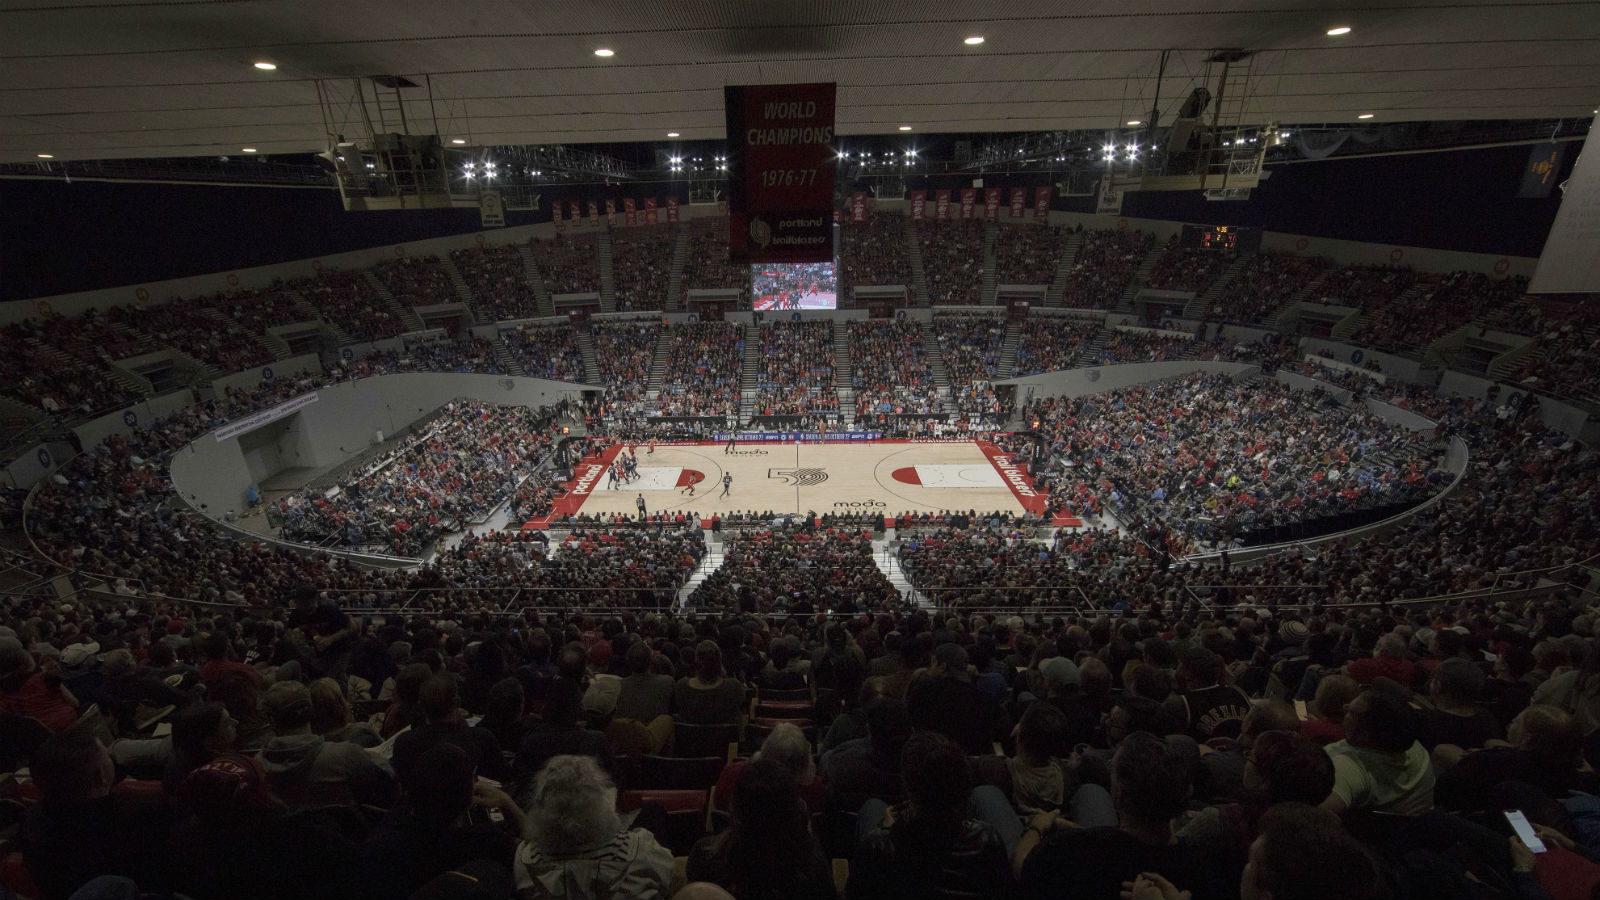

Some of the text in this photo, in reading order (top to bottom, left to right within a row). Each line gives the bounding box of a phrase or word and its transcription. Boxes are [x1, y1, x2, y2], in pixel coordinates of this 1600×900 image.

[764, 100, 816, 120] WORLD
[747, 125, 833, 145] CHAMPIONS
[761, 168, 817, 187] 1976-77
[779, 216, 824, 230] portland
[572, 464, 603, 495] portland
[833, 498, 887, 508] moda
